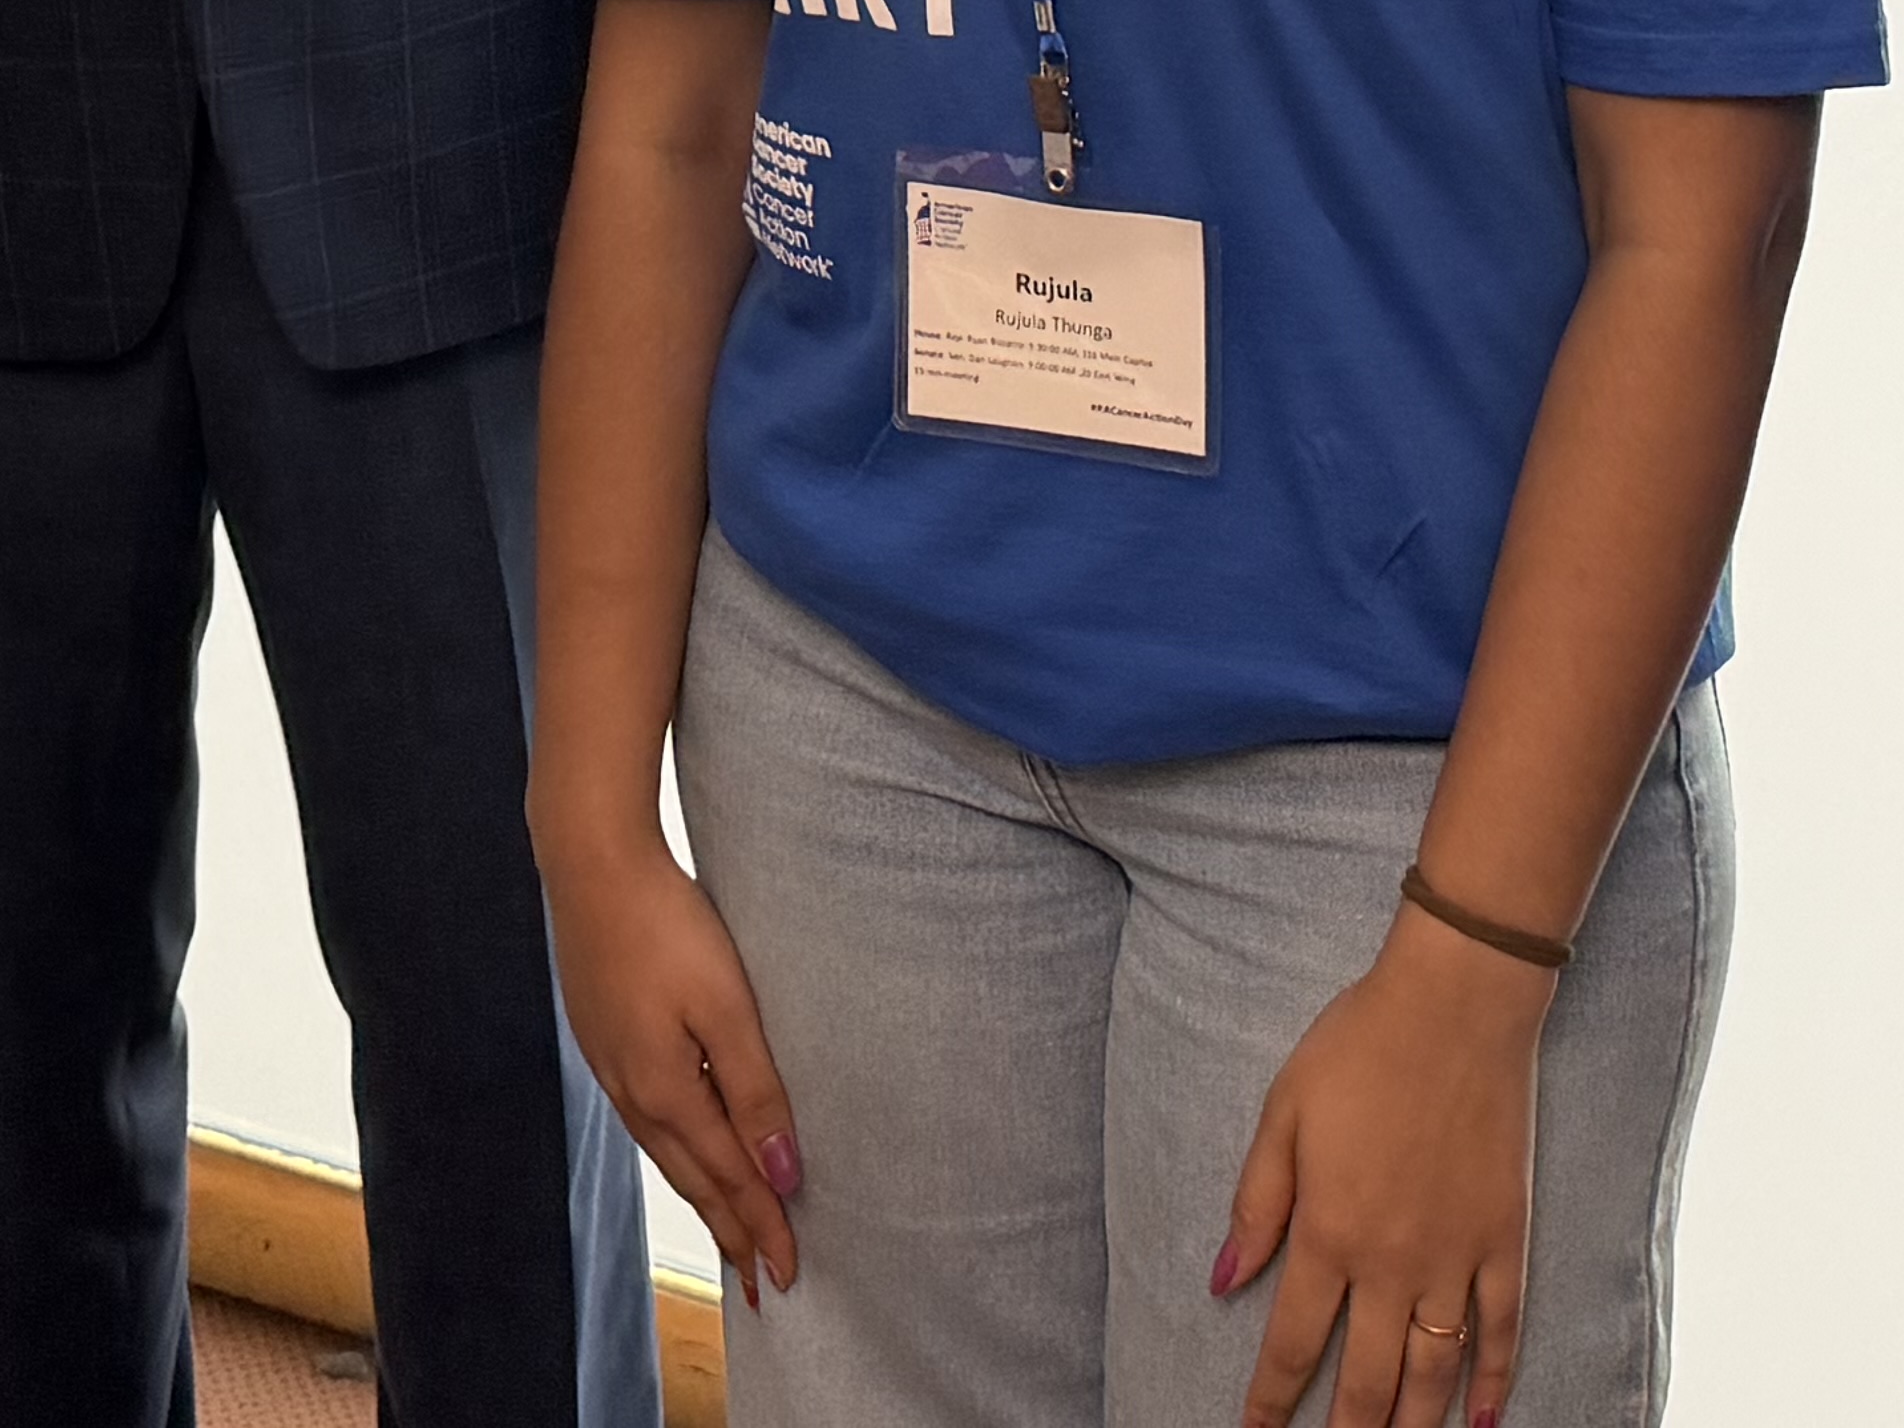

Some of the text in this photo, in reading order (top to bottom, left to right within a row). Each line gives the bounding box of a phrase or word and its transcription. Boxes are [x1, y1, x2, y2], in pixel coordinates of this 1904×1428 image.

[752, 182, 815, 228] Cancer
[1015, 272, 1093, 304] Rujula
[995, 308, 1047, 331] Rujula
[1052, 315, 1113, 342] Thunga
